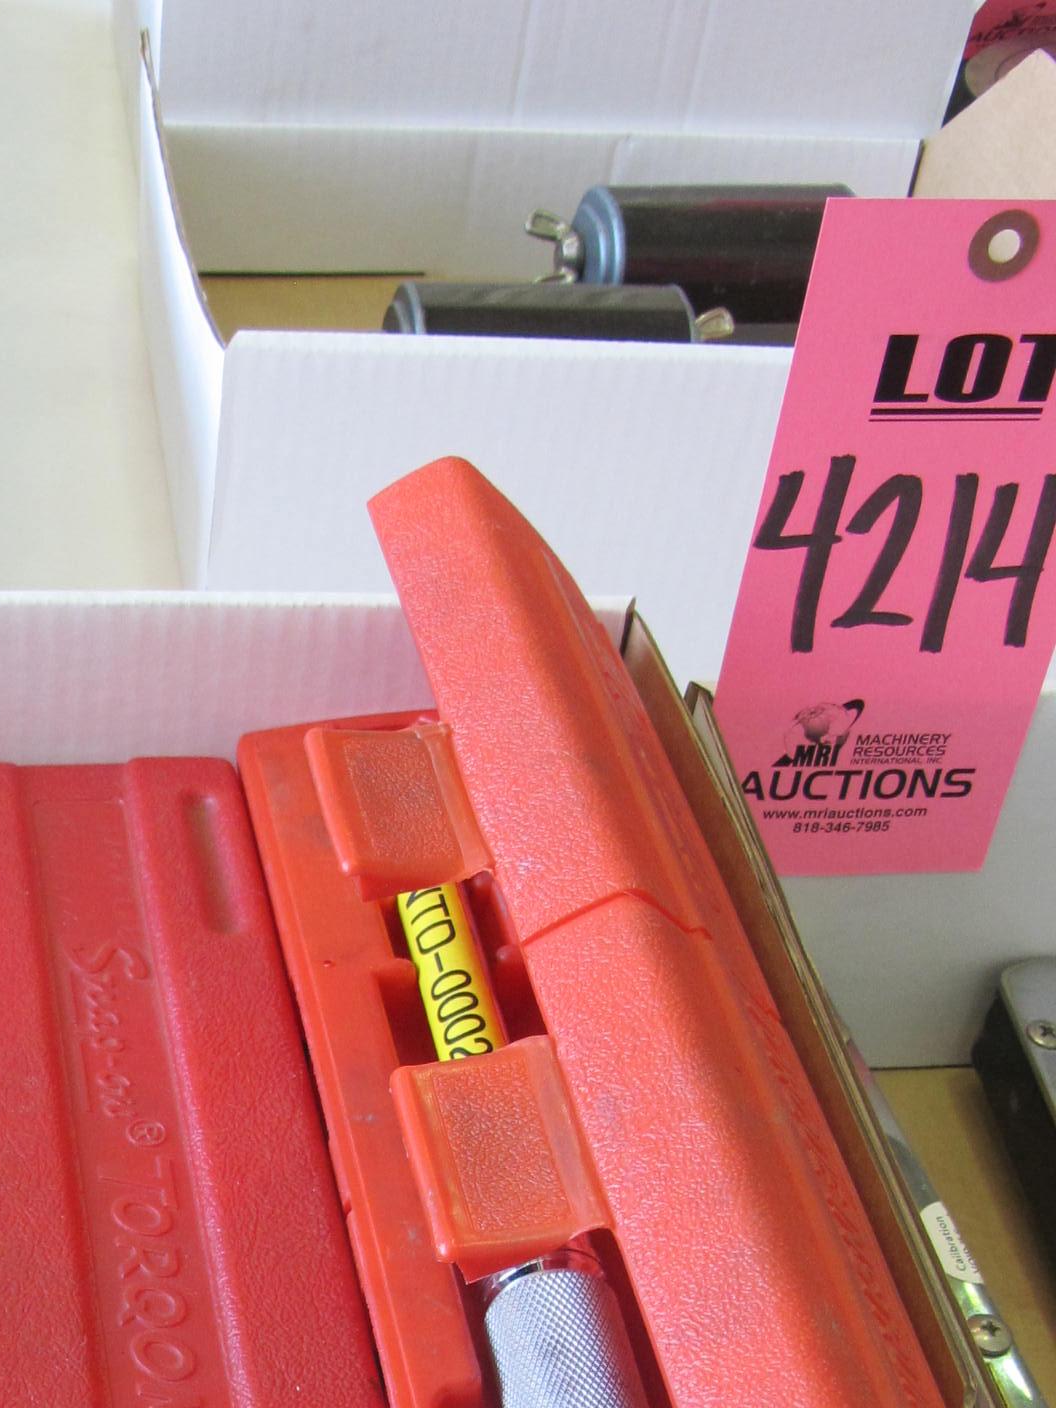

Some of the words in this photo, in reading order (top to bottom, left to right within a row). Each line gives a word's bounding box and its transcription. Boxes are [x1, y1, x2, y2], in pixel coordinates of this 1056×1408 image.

[873, 333, 1056, 404] LOT
[752, 453, 1056, 653] 4214
[855, 733, 953, 746] MACHINERY
[792, 740, 847, 768] MRI
[850, 757, 921, 765] INTERNATIONAL
[852, 745, 947, 757] RESOURCES
[741, 768, 976, 801] AUCTIONS
[762, 806, 928, 819] www.mriauctions.com
[792, 820, 890, 833] 818-346-7985
[936, 1215, 967, 1272] Calibration
